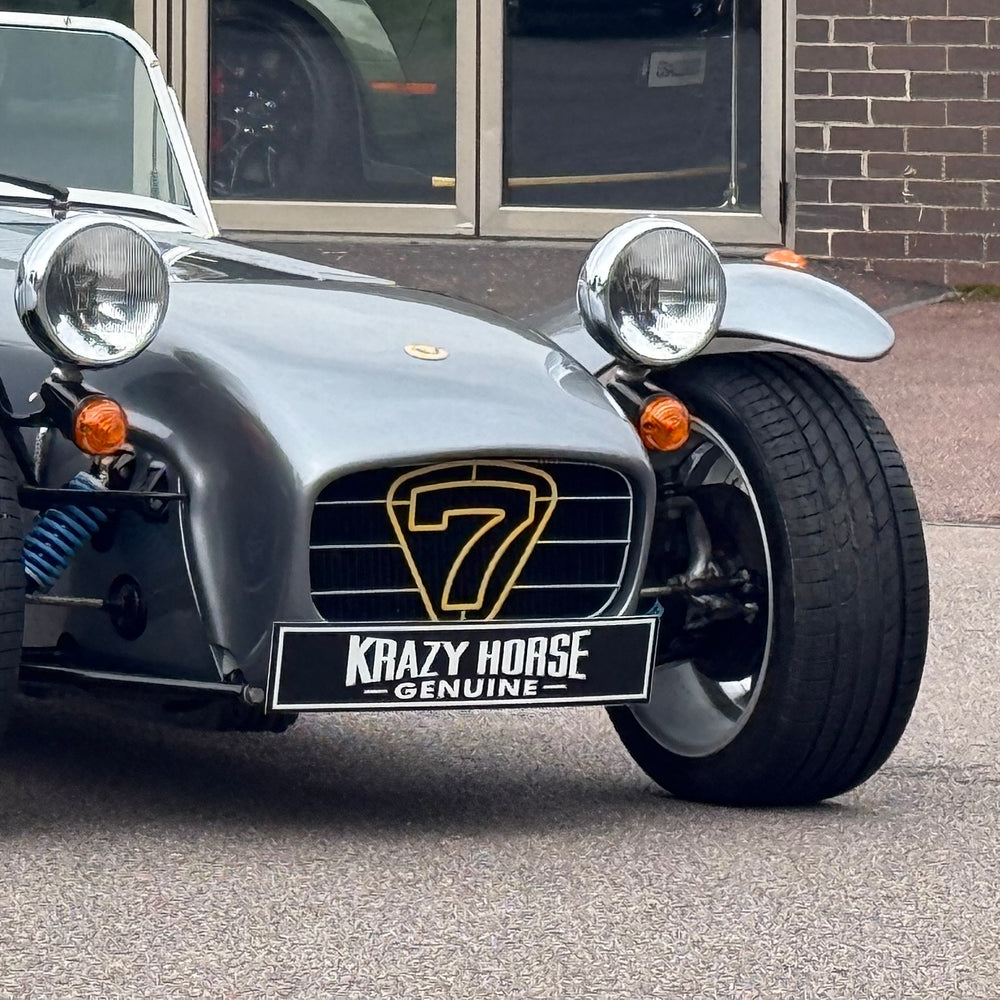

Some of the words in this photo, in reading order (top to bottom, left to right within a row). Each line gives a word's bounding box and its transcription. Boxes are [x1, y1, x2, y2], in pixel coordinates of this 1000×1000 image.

[408, 479, 537, 611] 7
[345, 634, 469, 687] KRAZY
[477, 629, 592, 680] HORSE
[394, 678, 539, 699] GENUINE
